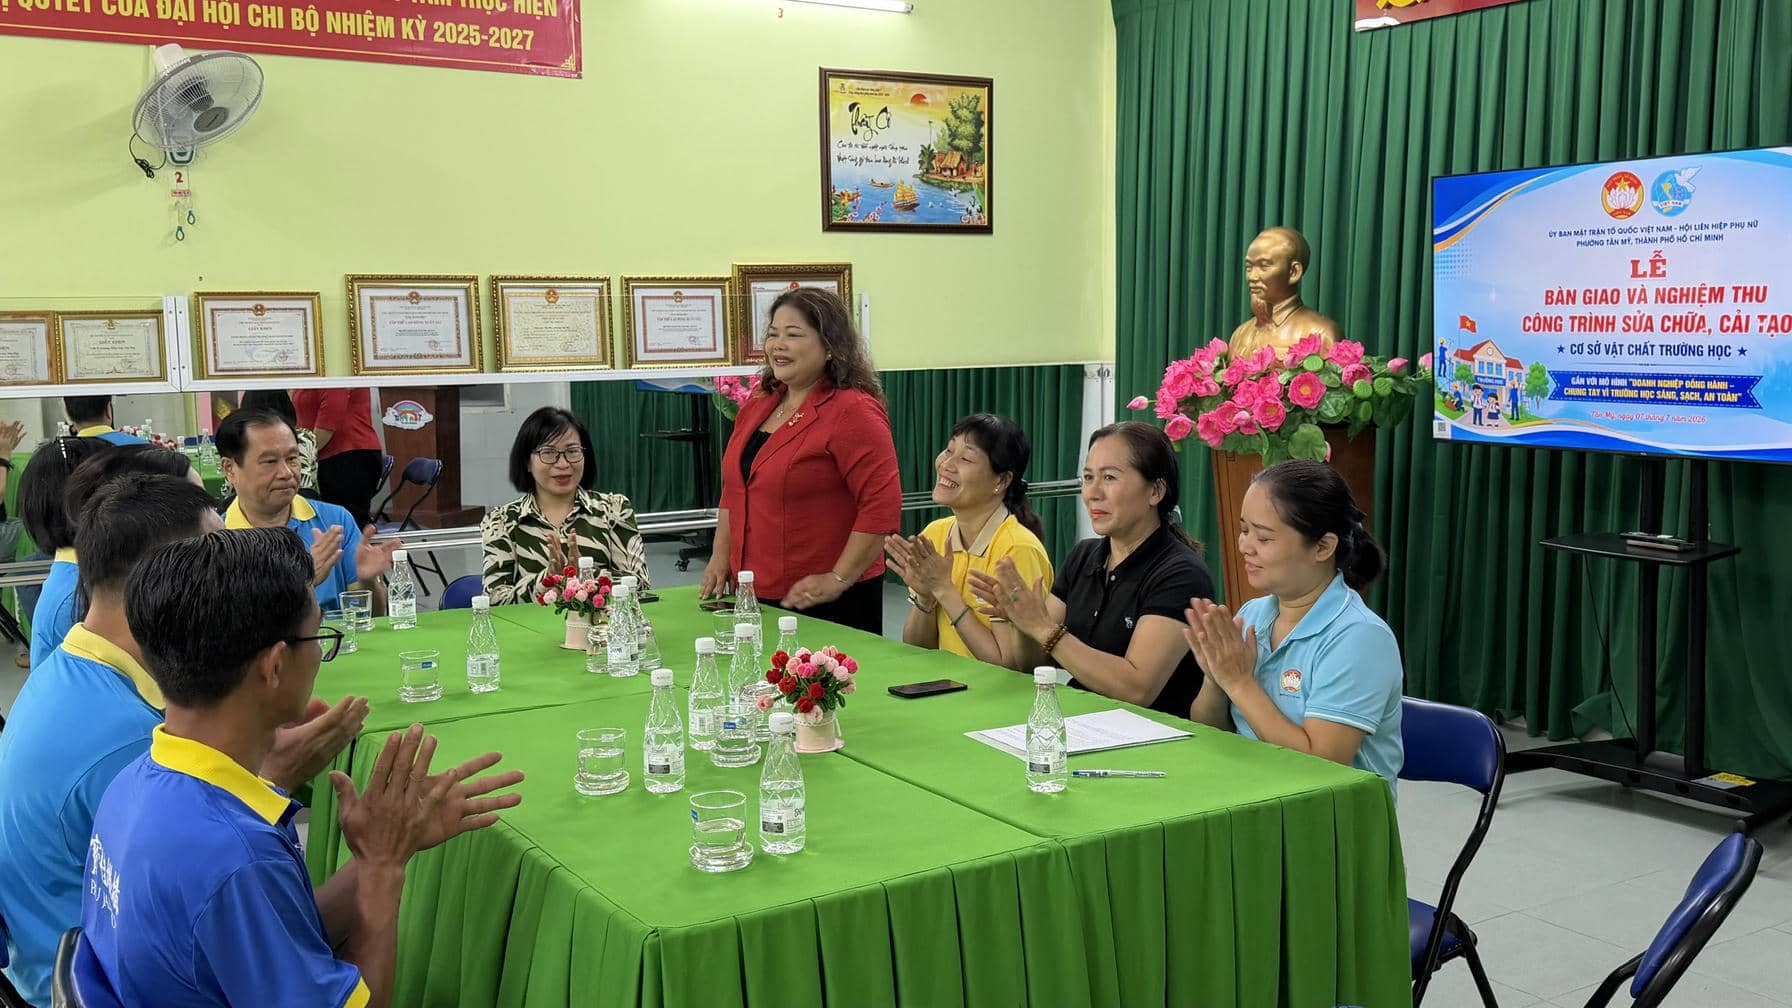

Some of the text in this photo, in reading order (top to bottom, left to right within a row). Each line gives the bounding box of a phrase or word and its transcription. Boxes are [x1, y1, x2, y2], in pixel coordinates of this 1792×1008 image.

[778, 8, 784, 18] 3
[156, 0, 196, 26] ĐẠI
[203, 0, 240, 30] HỘI
[248, 4, 284, 29] CHI
[291, 5, 319, 37] BỘ
[326, 10, 395, 41] NHIỆM
[401, 14, 427, 41] KỲ
[433, 21, 535, 50] 2025-2027
[174, 171, 183, 183] 2
[1574, 228, 1587, 237] MẶT
[1589, 228, 1605, 237] TRẬN
[1607, 226, 1616, 235] TỔ
[1618, 225, 1638, 235] QUỐC
[1640, 225, 1654, 234] VIỆT
[1656, 225, 1672, 233] NAM
[1680, 223, 1692, 232] HỘI
[1694, 222, 1709, 231] LIÊN
[1712, 221, 1728, 231] HIỆP
[1730, 221, 1745, 231] PHỤ
[1747, 220, 1758, 228] NỮ
[1577, 239, 1604, 247] PHƯỜNG
[1606, 238, 1619, 246] TÂN
[1635, 236, 1658, 244] THÀNH
[1660, 234, 1675, 243] PHỐ
[1677, 234, 1687, 243] HỒ
[1690, 233, 1702, 242] CHÍ
[1704, 233, 1724, 241] MINH
[1630, 250, 1667, 278] LỄ
[1544, 283, 1768, 308] BÀN GIAO VÀ NGHIỆM THU
[1522, 309, 1792, 338] CÔNG TRÌNH SỬA CHỮA, CẢI TẠO
[1570, 340, 1732, 360] CƠ SỞ VẬT CHẤT TRƯỜNG HỌC
[1571, 375, 1585, 385] GẮN
[1586, 376, 1597, 386] VỚI
[1657, 379, 1684, 390] NGHIỆP
[1685, 378, 1705, 389] ĐỒNG
[1707, 380, 1728, 389] HÀNH
[1564, 387, 1587, 396] CHUNG
[1588, 388, 1600, 396] TAY
[1602, 387, 1609, 397] VÌ
[1611, 388, 1638, 398] TRƯỜNG
[1640, 390, 1655, 400] HỌC
[1656, 390, 1679, 401] SÁNG,
[1680, 391, 1702, 402] SẠCH,
[1704, 392, 1715, 401] AN
[1688, 415, 1706, 423] 2026
